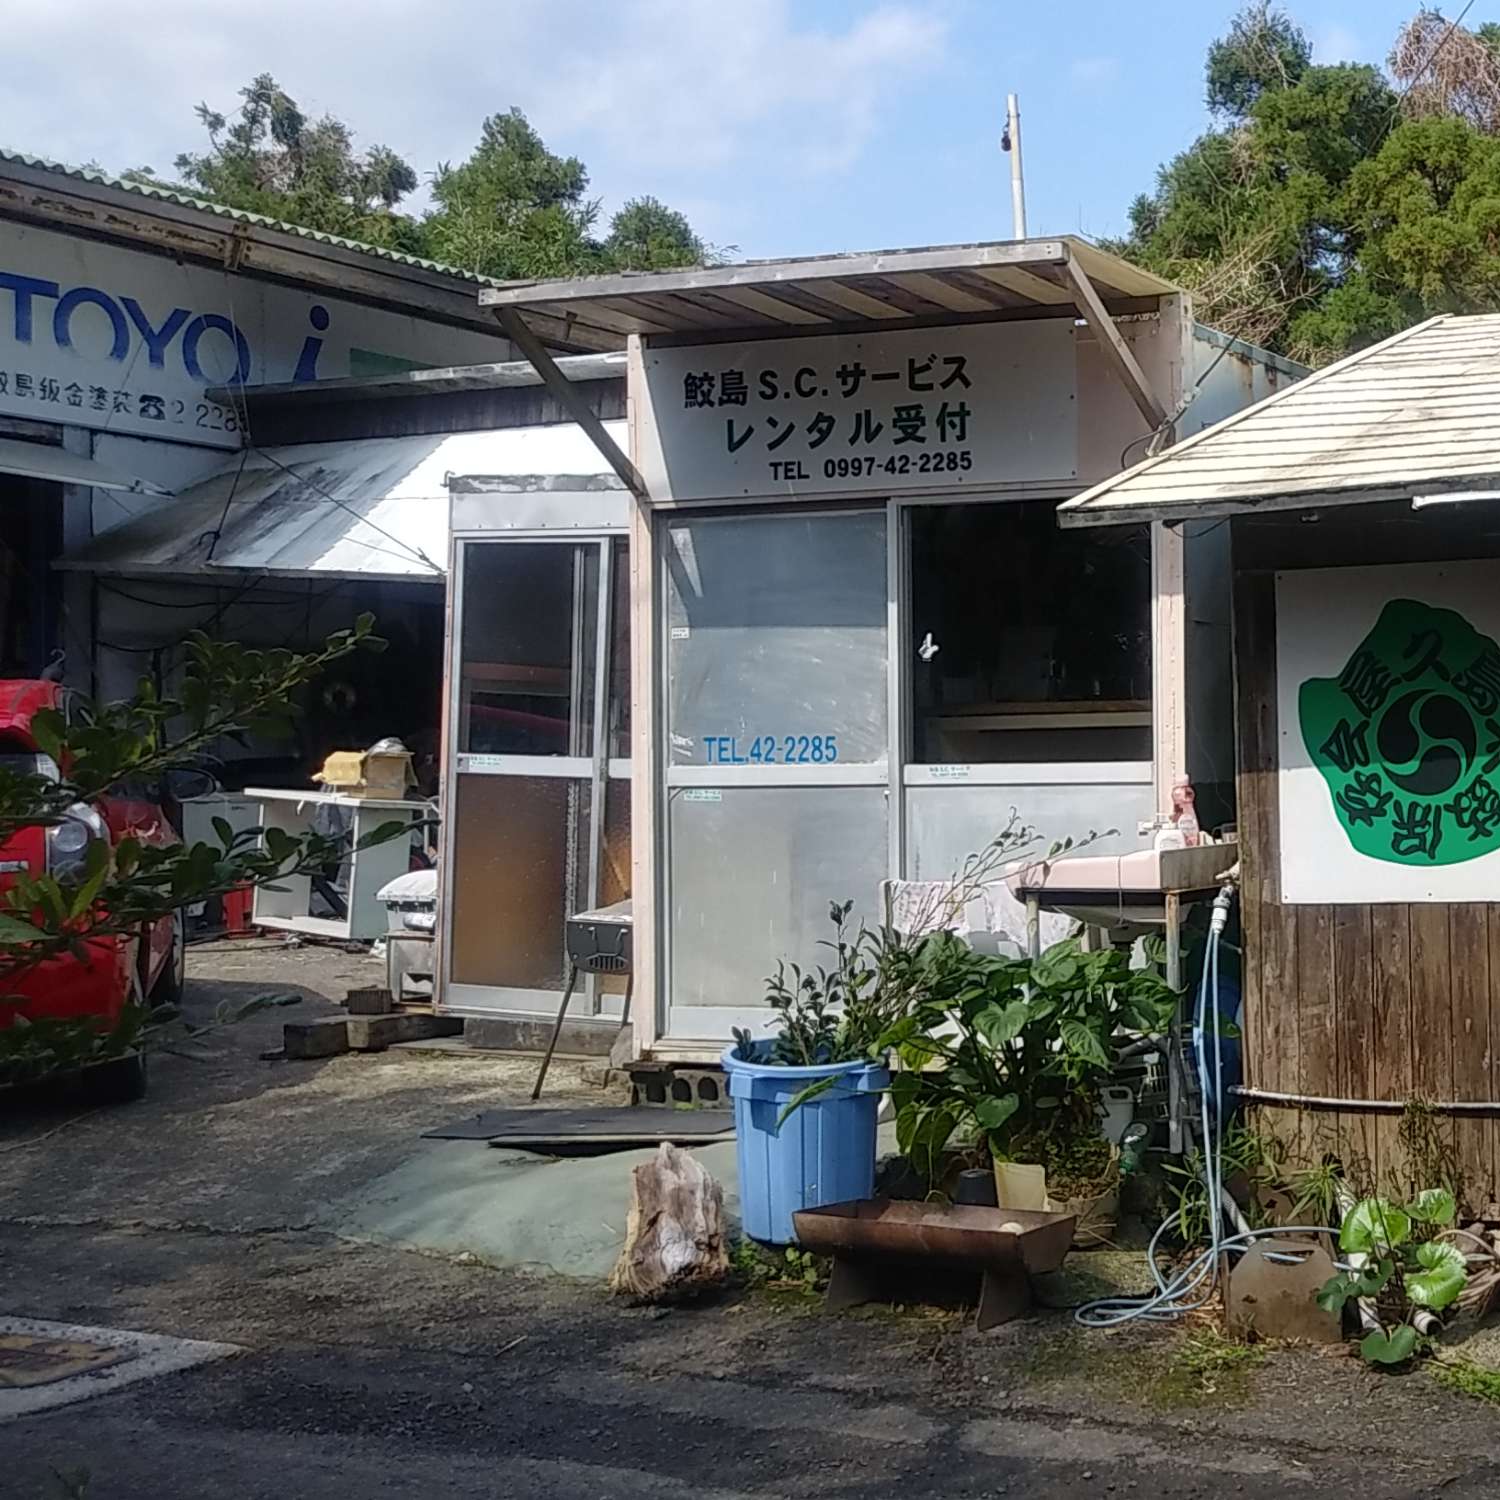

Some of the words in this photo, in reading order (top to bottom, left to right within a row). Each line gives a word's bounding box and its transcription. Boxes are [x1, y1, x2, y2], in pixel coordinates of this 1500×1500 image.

[0, 272, 251, 385] TOYO
[726, 401, 972, 453] レンタル受付
[769, 460, 810, 481] TEL
[823, 450, 973, 479] 0997-42-2285
[703, 735, 838, 762] TEL.42-2285
